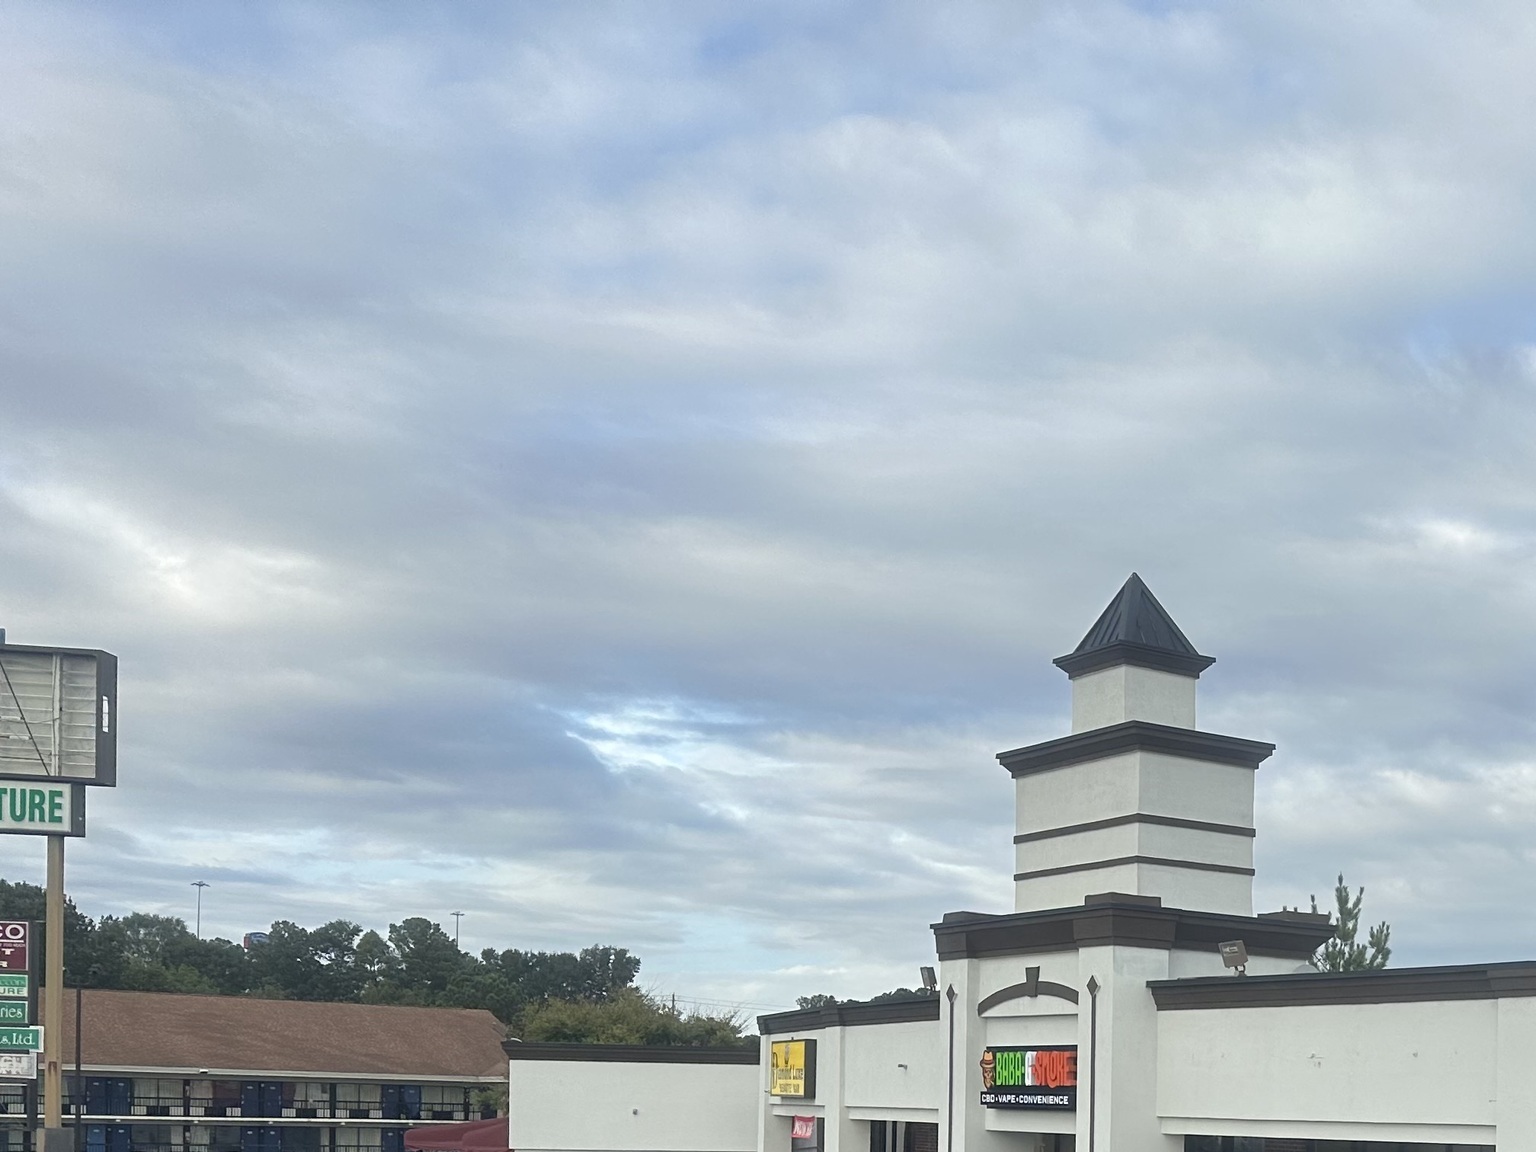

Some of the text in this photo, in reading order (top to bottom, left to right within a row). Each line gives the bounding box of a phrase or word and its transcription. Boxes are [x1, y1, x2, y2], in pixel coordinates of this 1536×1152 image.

[0, 924, 25, 940] O
[12, 1032, 36, 1045] Ltd.
[998, 1094, 1016, 1103] VAPE
[1019, 1095, 1069, 1105] CONVENIENCE
